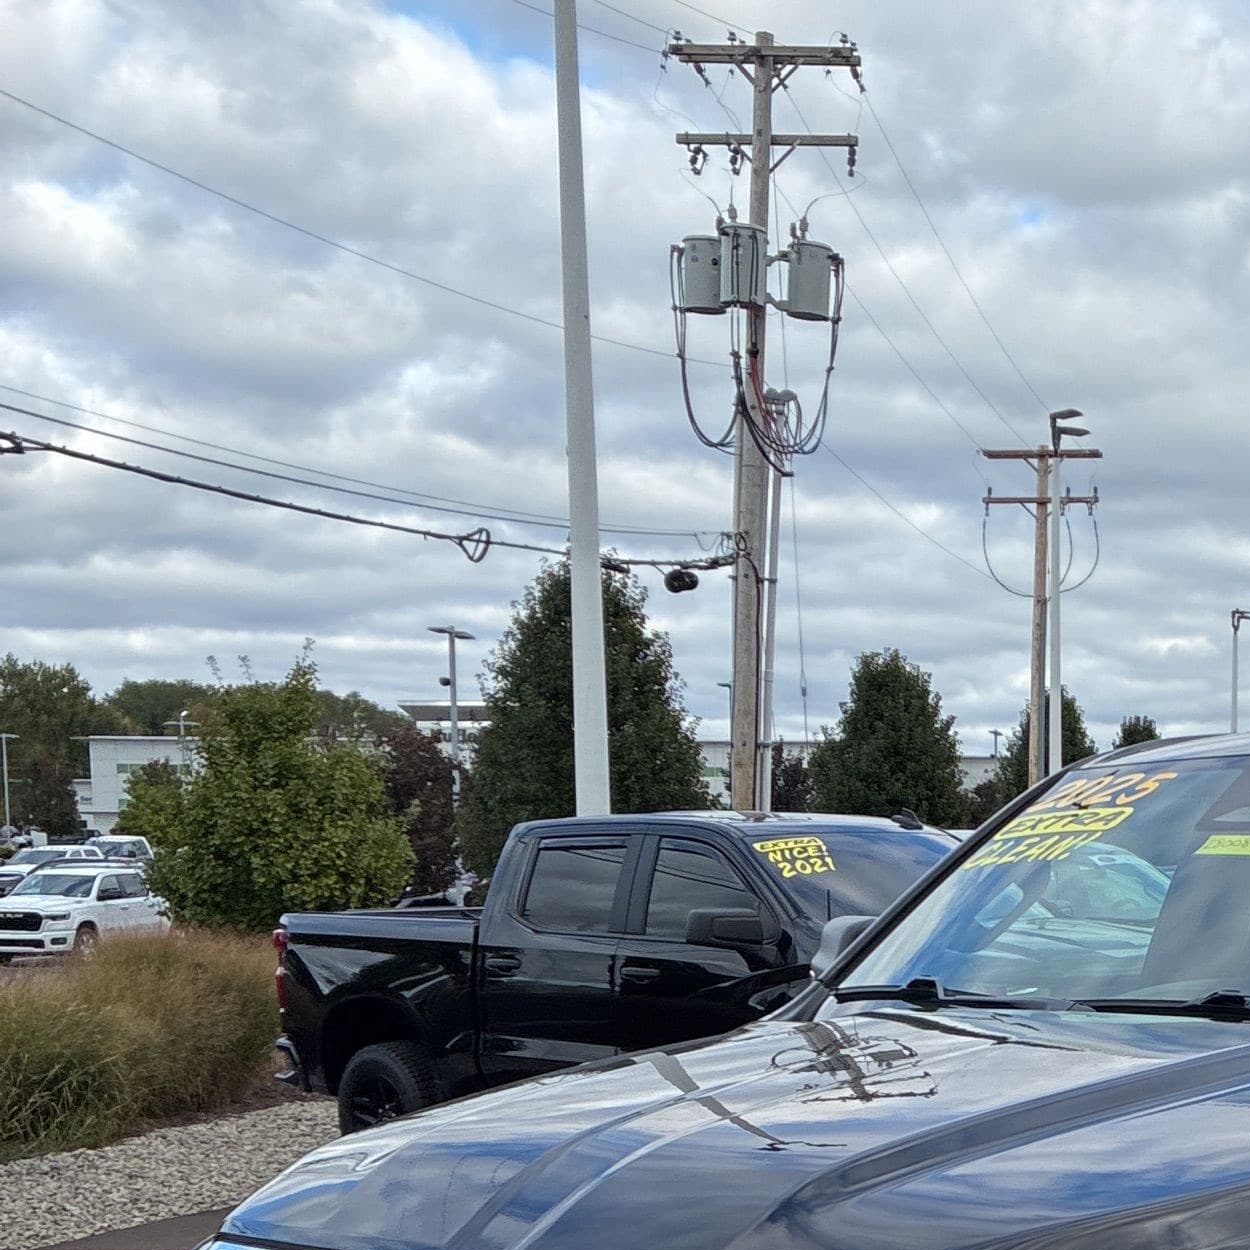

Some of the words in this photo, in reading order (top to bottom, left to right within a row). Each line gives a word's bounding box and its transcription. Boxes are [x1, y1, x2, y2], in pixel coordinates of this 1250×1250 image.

[1027, 772, 1179, 813] 2025
[1006, 810, 1126, 833] EXTRA
[760, 839, 819, 850] EXTRA
[777, 856, 837, 879] 2021
